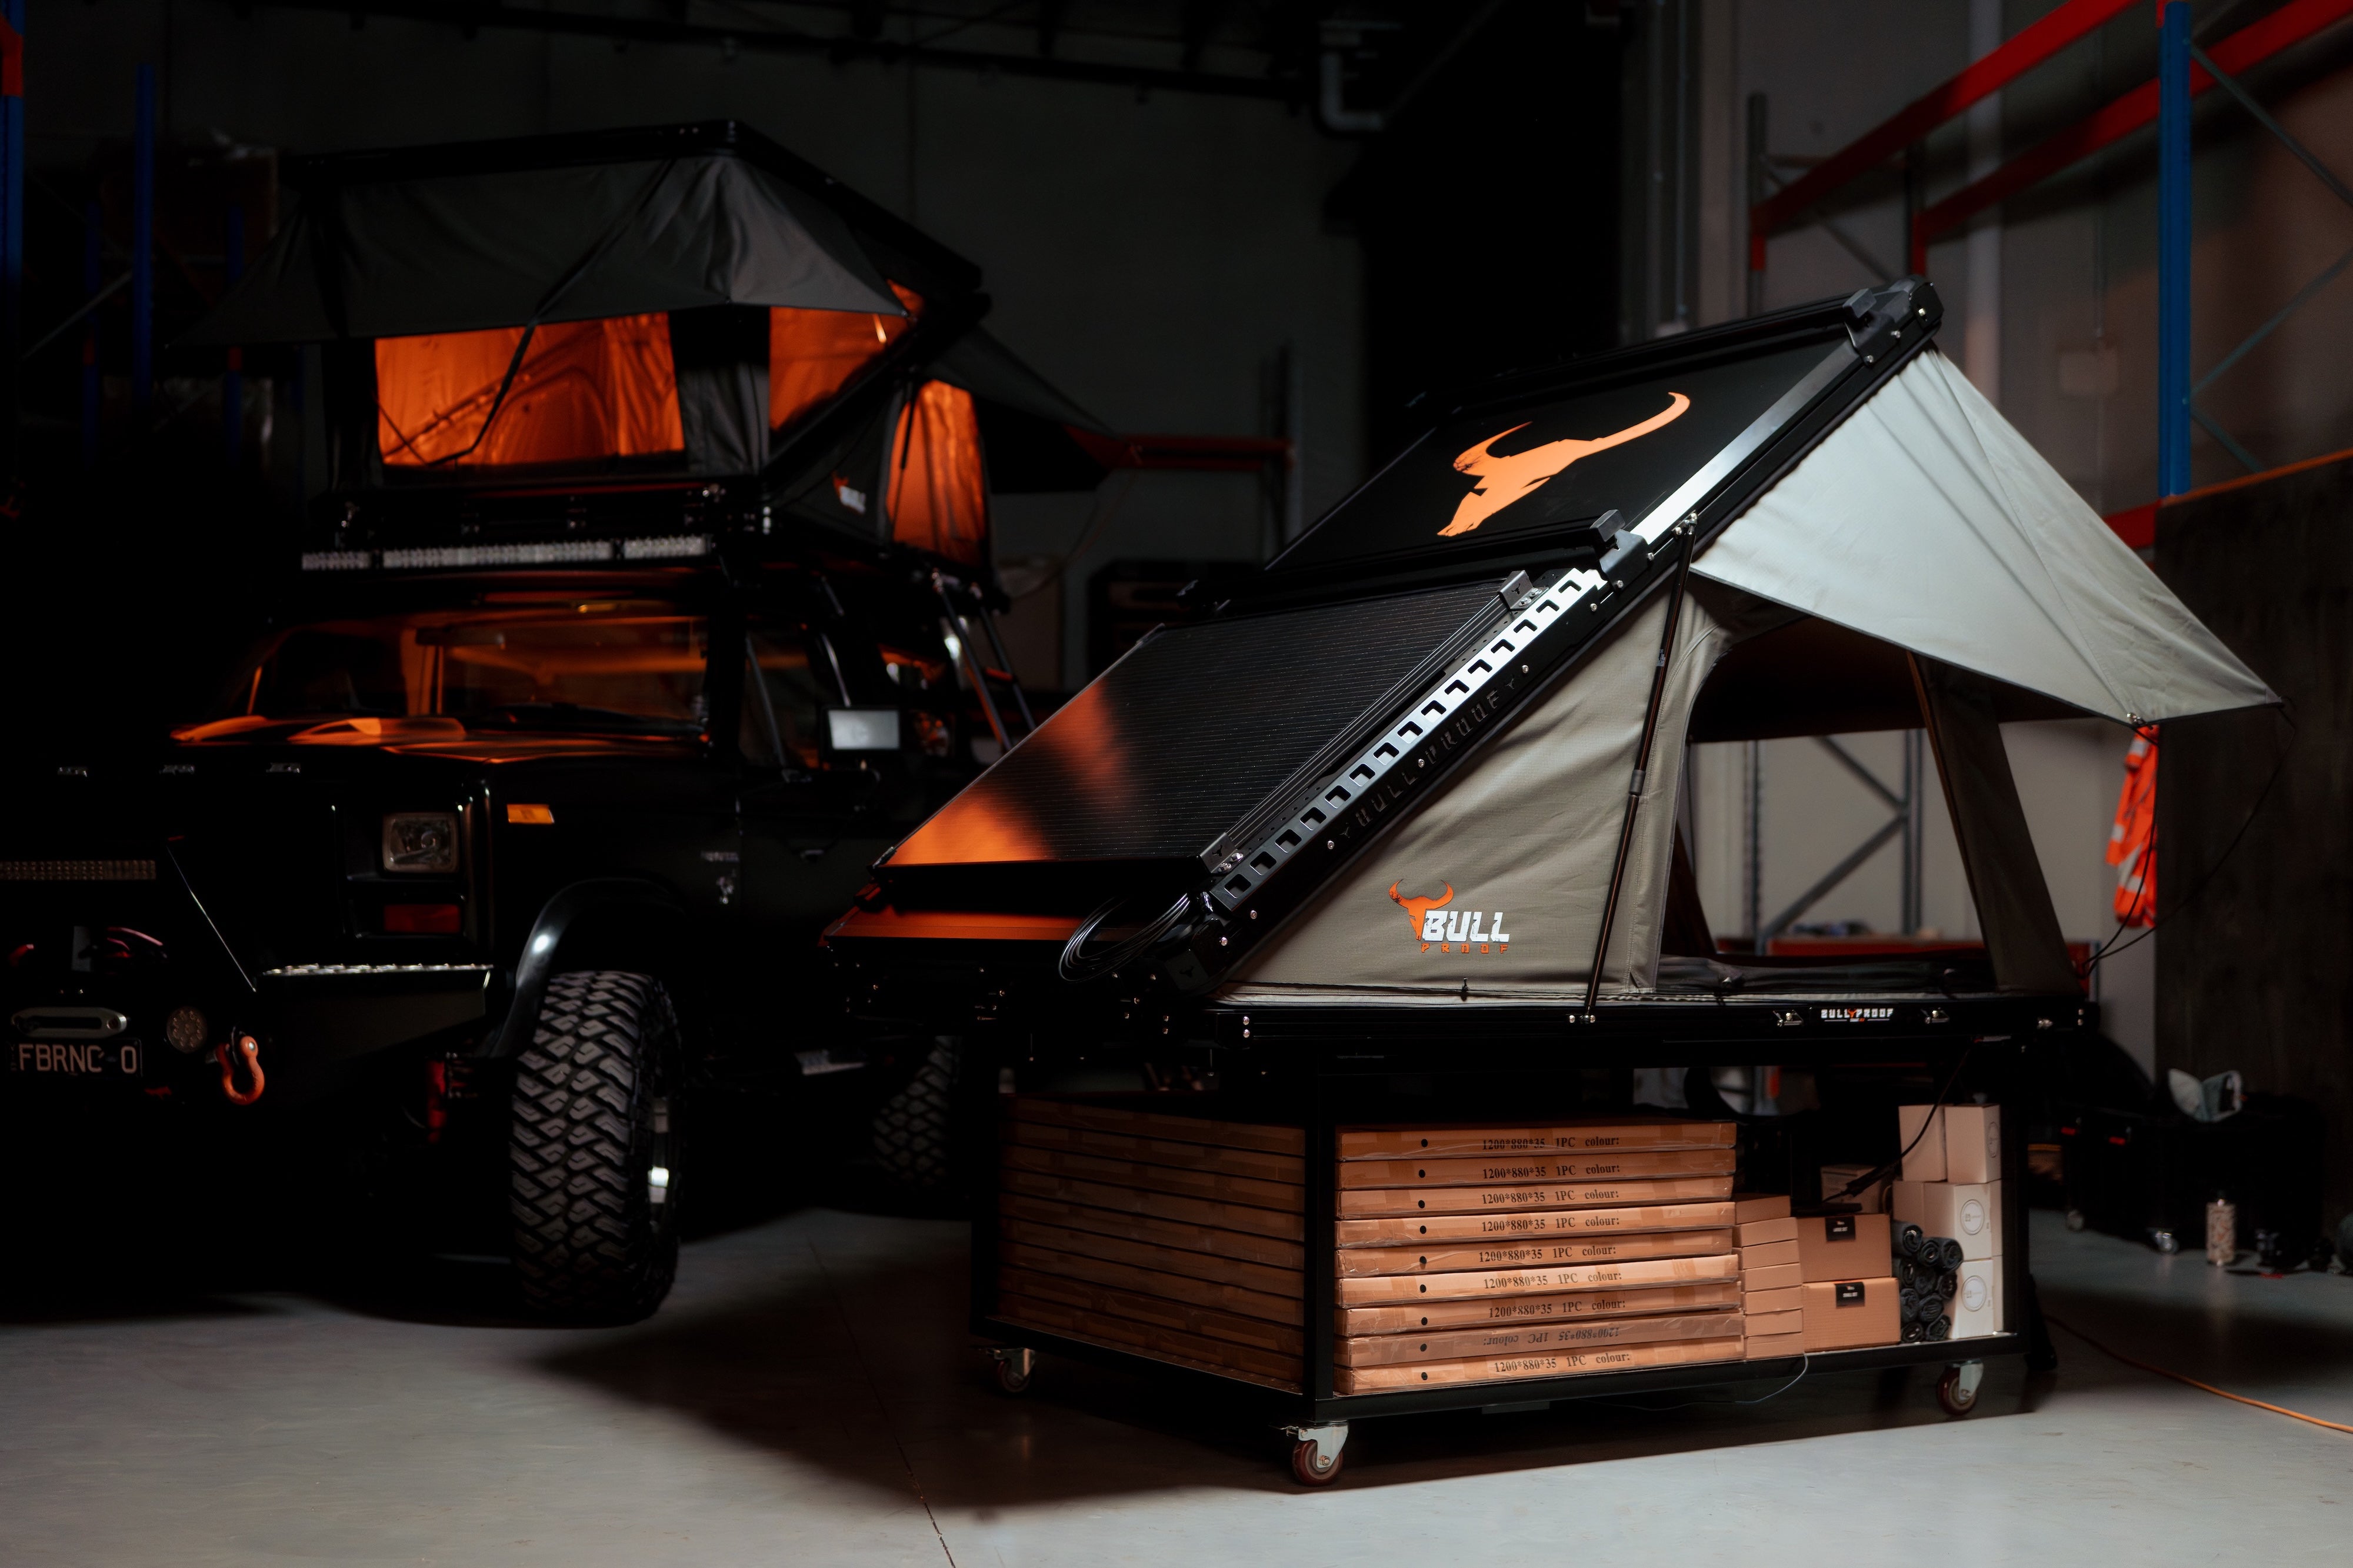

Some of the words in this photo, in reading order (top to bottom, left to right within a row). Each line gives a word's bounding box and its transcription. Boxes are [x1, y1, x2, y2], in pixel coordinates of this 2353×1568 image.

[1422, 910, 1510, 942] BULL
[1421, 943, 1508, 953] PROOF
[1557, 1165, 1577, 1176] 1PC
[1586, 1164, 1620, 1175] colour:
[1555, 1190, 1575, 1201] 1PC
[1585, 1189, 1619, 1199] colour:
[1556, 1217, 1576, 1229] 1PC
[1585, 1216, 1619, 1226] colour:
[1553, 1247, 1572, 1258] 1PC
[1582, 1245, 1616, 1256] colour:
[1557, 1273, 1578, 1284] 1PC
[1588, 1271, 1622, 1282] colour:
[1562, 1301, 1582, 1313] 1PC
[1592, 1299, 1625, 1310] colour:
[1566, 1355, 1587, 1367] 1PC
[1596, 1353, 1630, 1364] colour:
